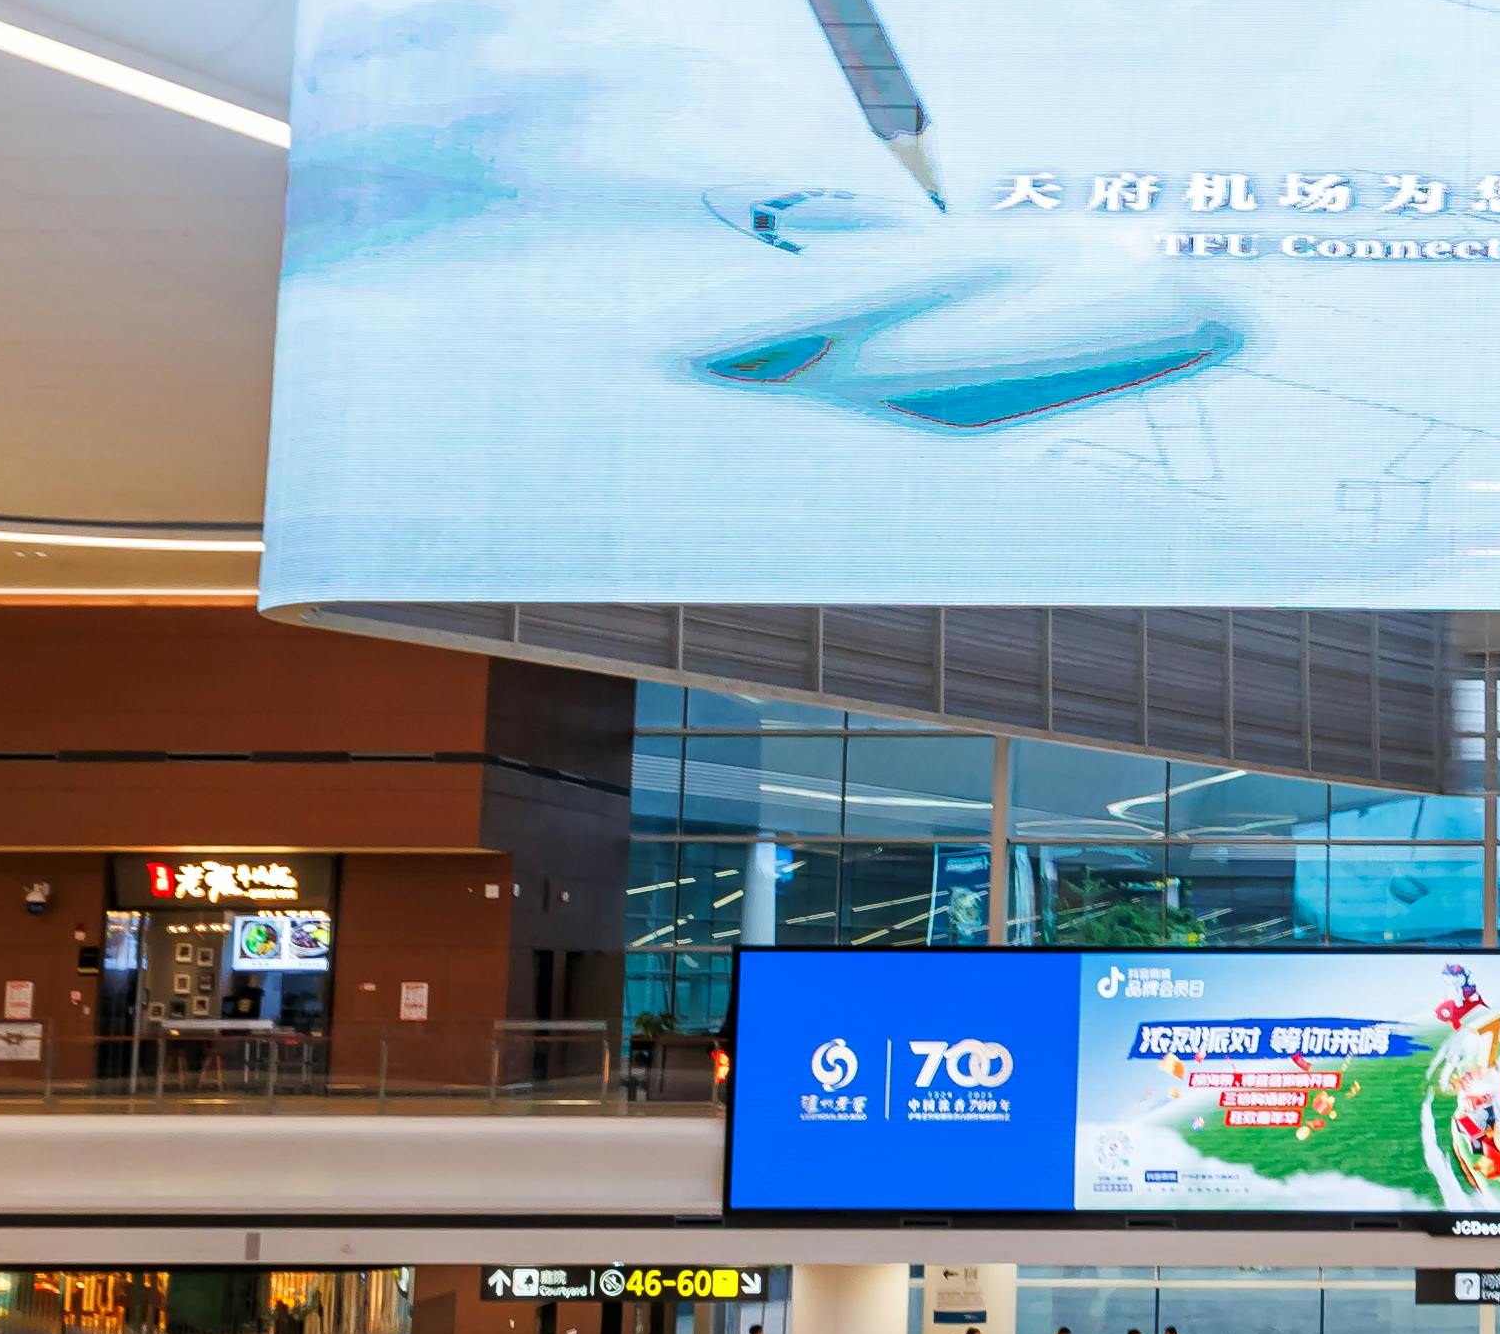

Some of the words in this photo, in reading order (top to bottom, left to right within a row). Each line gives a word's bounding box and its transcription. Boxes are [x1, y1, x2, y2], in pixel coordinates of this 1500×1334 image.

[1157, 231, 1261, 262] TFU
[909, 1038, 1014, 1088] 700
[538, 1284, 588, 1298] Courtyard
[626, 1269, 712, 1297] 46-60
